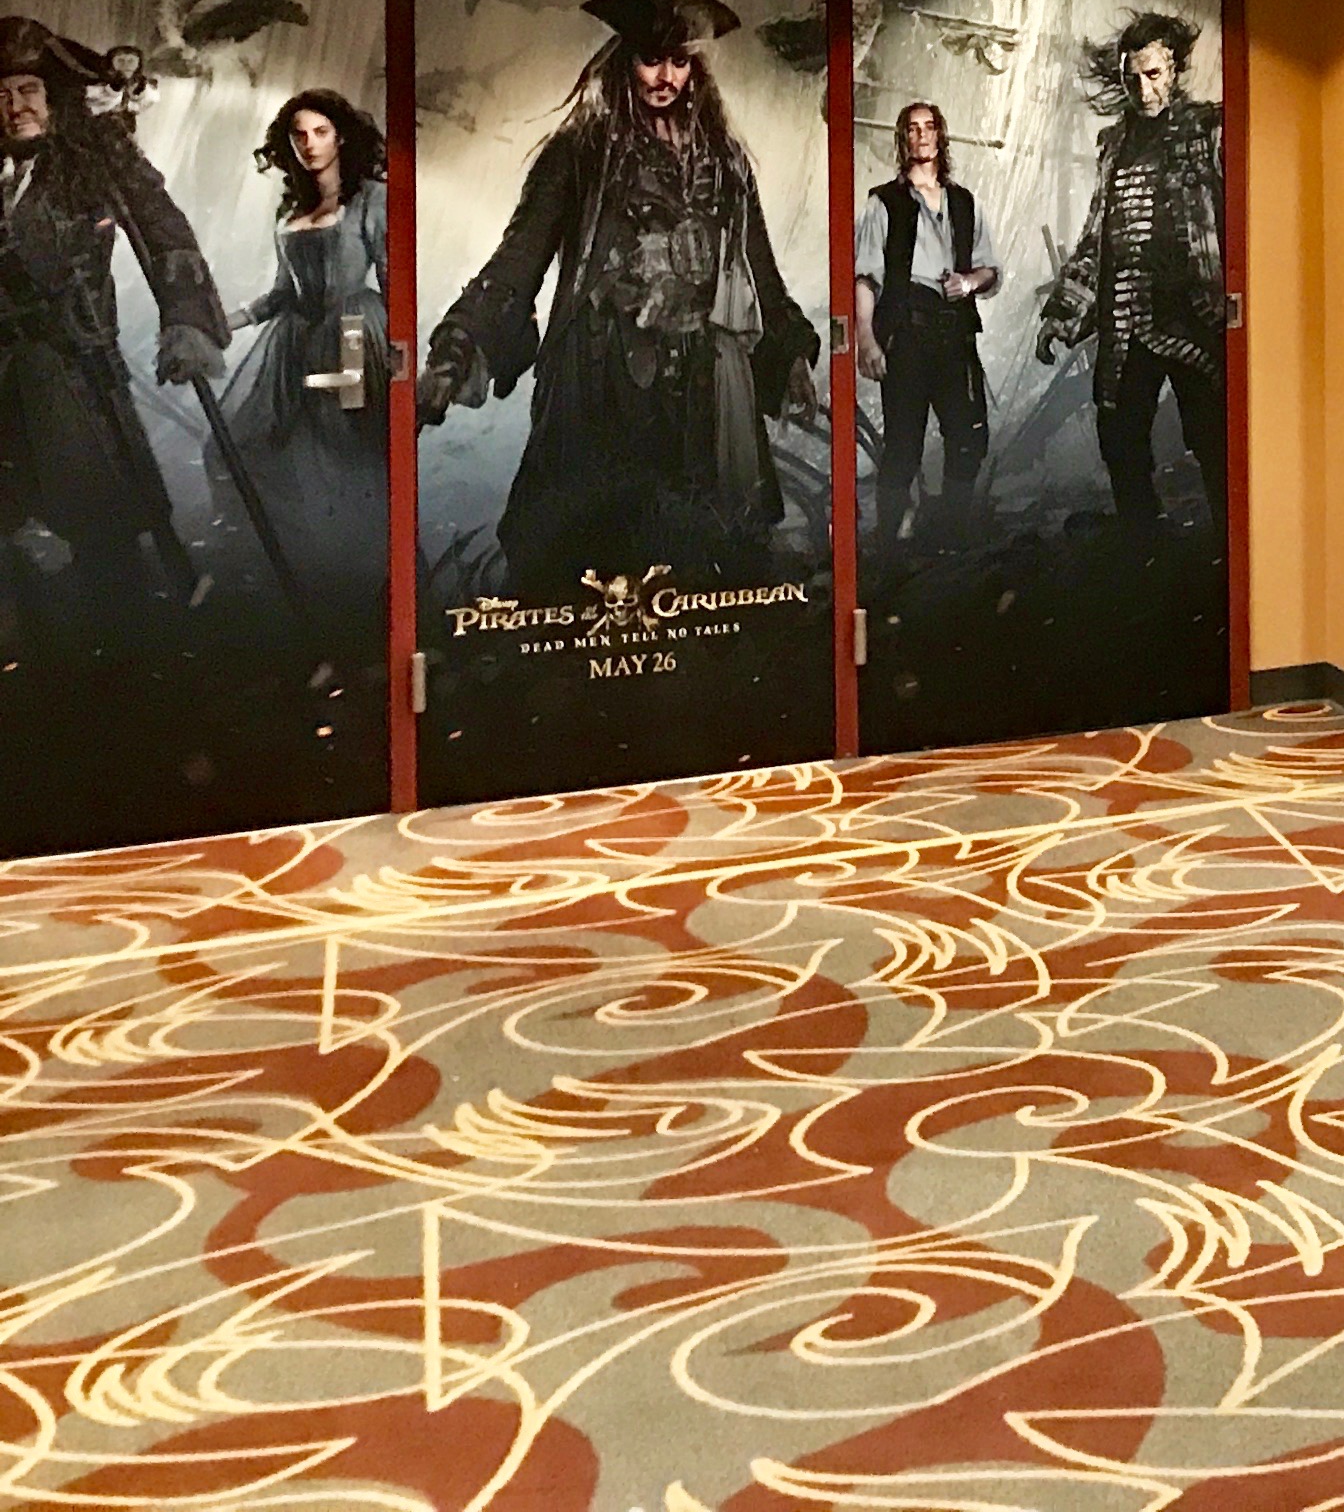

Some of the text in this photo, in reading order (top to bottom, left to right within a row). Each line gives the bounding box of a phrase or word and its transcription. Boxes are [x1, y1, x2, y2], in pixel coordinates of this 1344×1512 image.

[445, 604, 575, 638] PIRATES
[651, 582, 809, 618] CARIBBEAN
[474, 596, 519, 612] Disney
[519, 621, 741, 654] DEAD MEN TELL NO TALES
[589, 651, 677, 680] MAY 26
